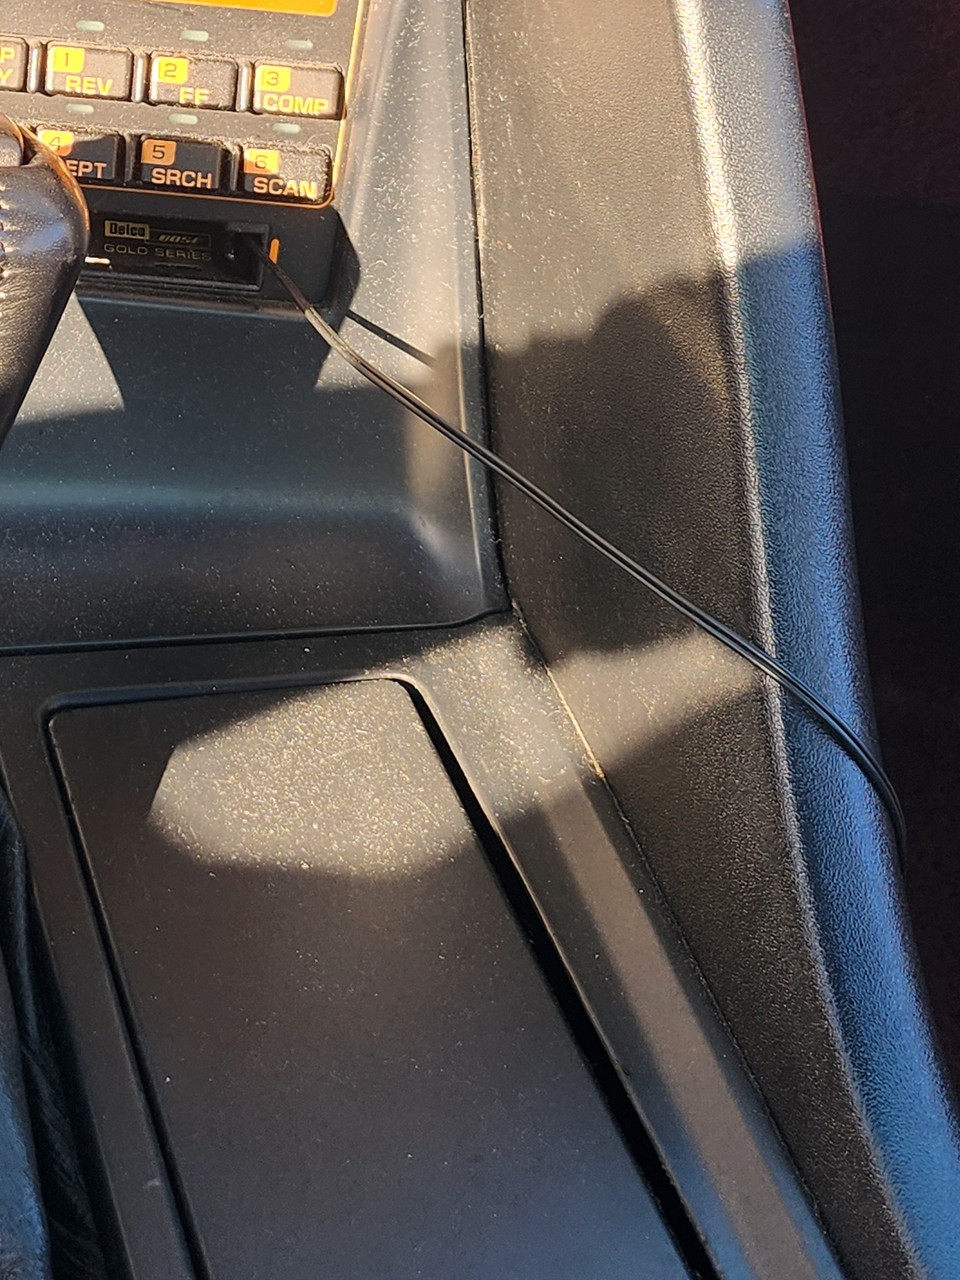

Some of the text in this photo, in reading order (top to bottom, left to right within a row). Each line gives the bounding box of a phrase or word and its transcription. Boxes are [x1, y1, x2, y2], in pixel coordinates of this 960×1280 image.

[63, 52, 70, 67] 1
[164, 62, 178, 77] 2
[266, 70, 281, 86] 3
[65, 76, 115, 96] REV
[179, 86, 210, 104] FF
[262, 95, 331, 115] COMP
[49, 136, 61, 151] 4
[152, 144, 166, 160] 5
[66, 159, 108, 179] EPT
[253, 153, 268, 170] 6
[151, 167, 212, 189] SRCH
[252, 176, 318, 198] SCAN
[103, 243, 213, 261] GOLD SERIES
